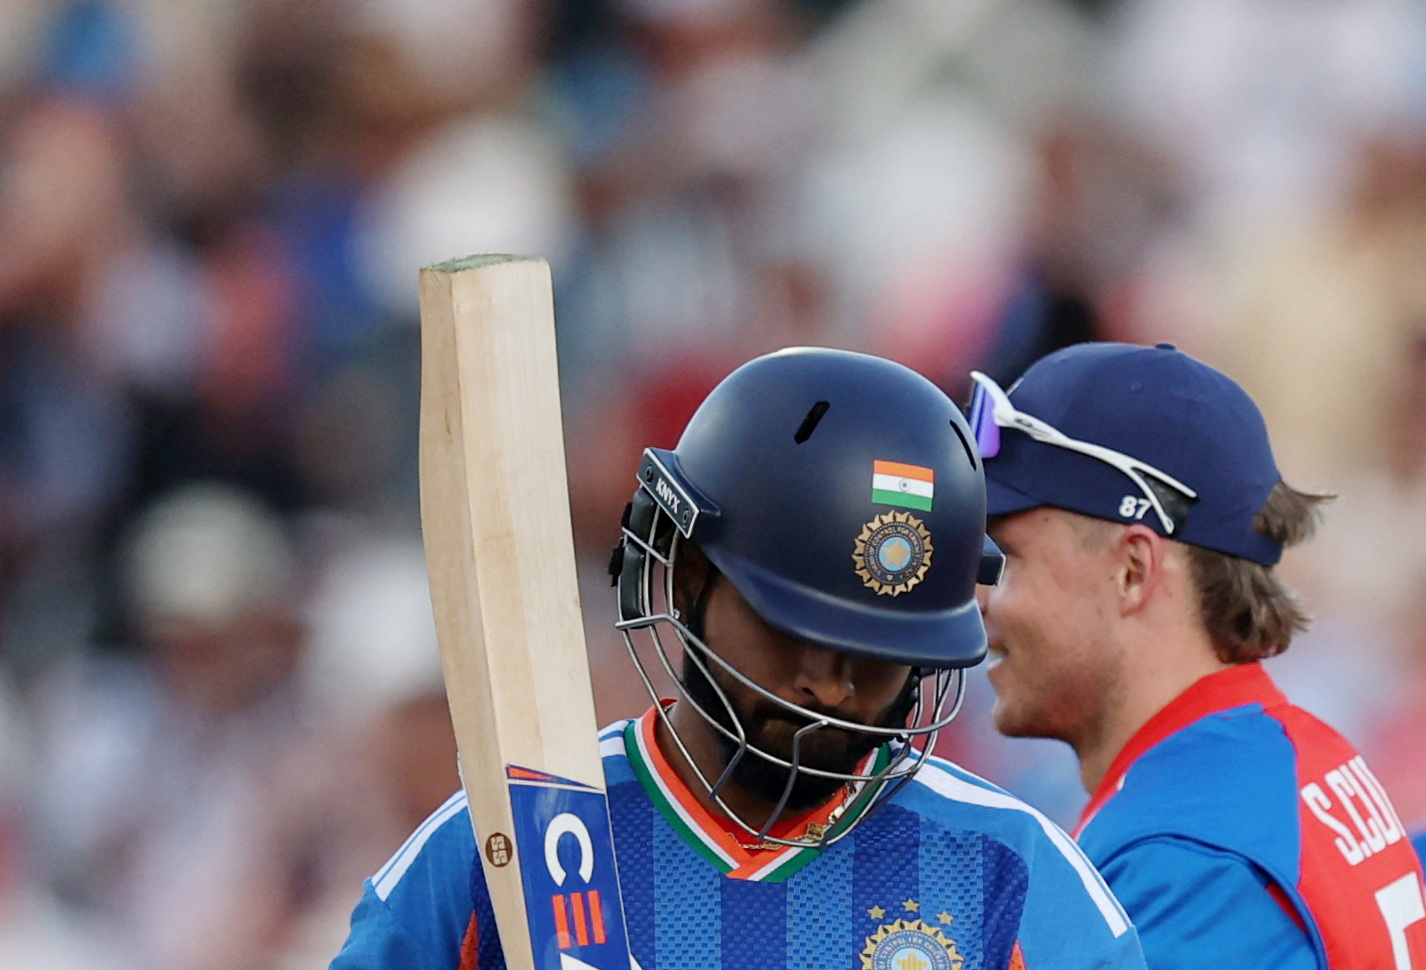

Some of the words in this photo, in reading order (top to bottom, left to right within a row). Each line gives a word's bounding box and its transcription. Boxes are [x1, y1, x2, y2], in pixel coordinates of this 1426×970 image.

[656, 478, 681, 514] KNYX
[1119, 495, 1152, 519] 87
[1301, 755, 1407, 866] S.CU
